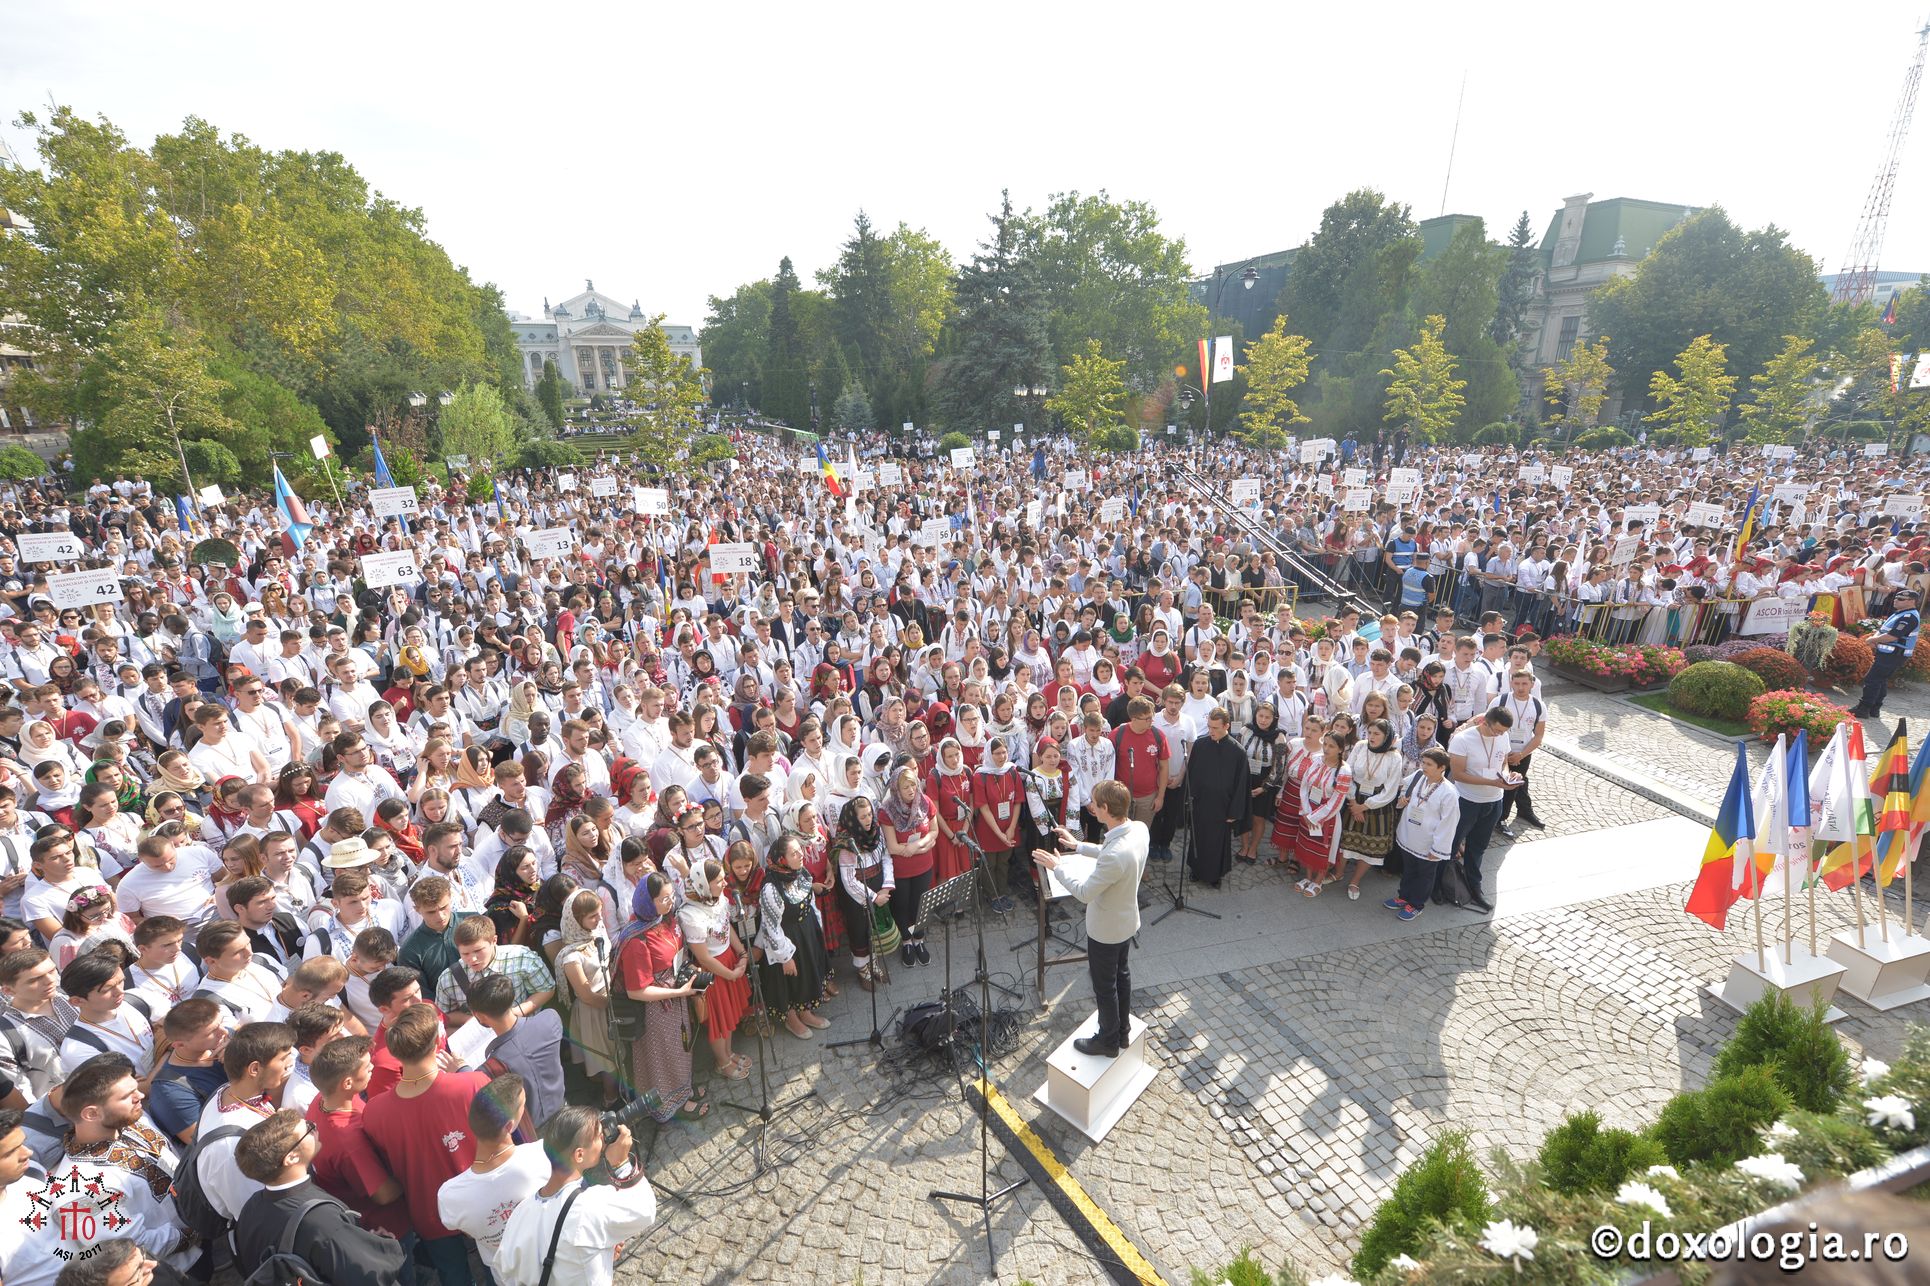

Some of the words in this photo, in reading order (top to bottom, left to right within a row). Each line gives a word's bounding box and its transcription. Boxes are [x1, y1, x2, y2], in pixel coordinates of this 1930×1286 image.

[401, 500, 415, 508] 32
[656, 502, 666, 510] 50
[1708, 516, 1719, 524] 43
[940, 530, 948, 539] 56
[57, 545, 74, 554] 42
[557, 540, 569, 550] 13
[739, 556, 752, 566] 18
[398, 566, 414, 576] 63
[96, 584, 117, 596] 42
[1756, 608, 1782, 616] ASCOR
